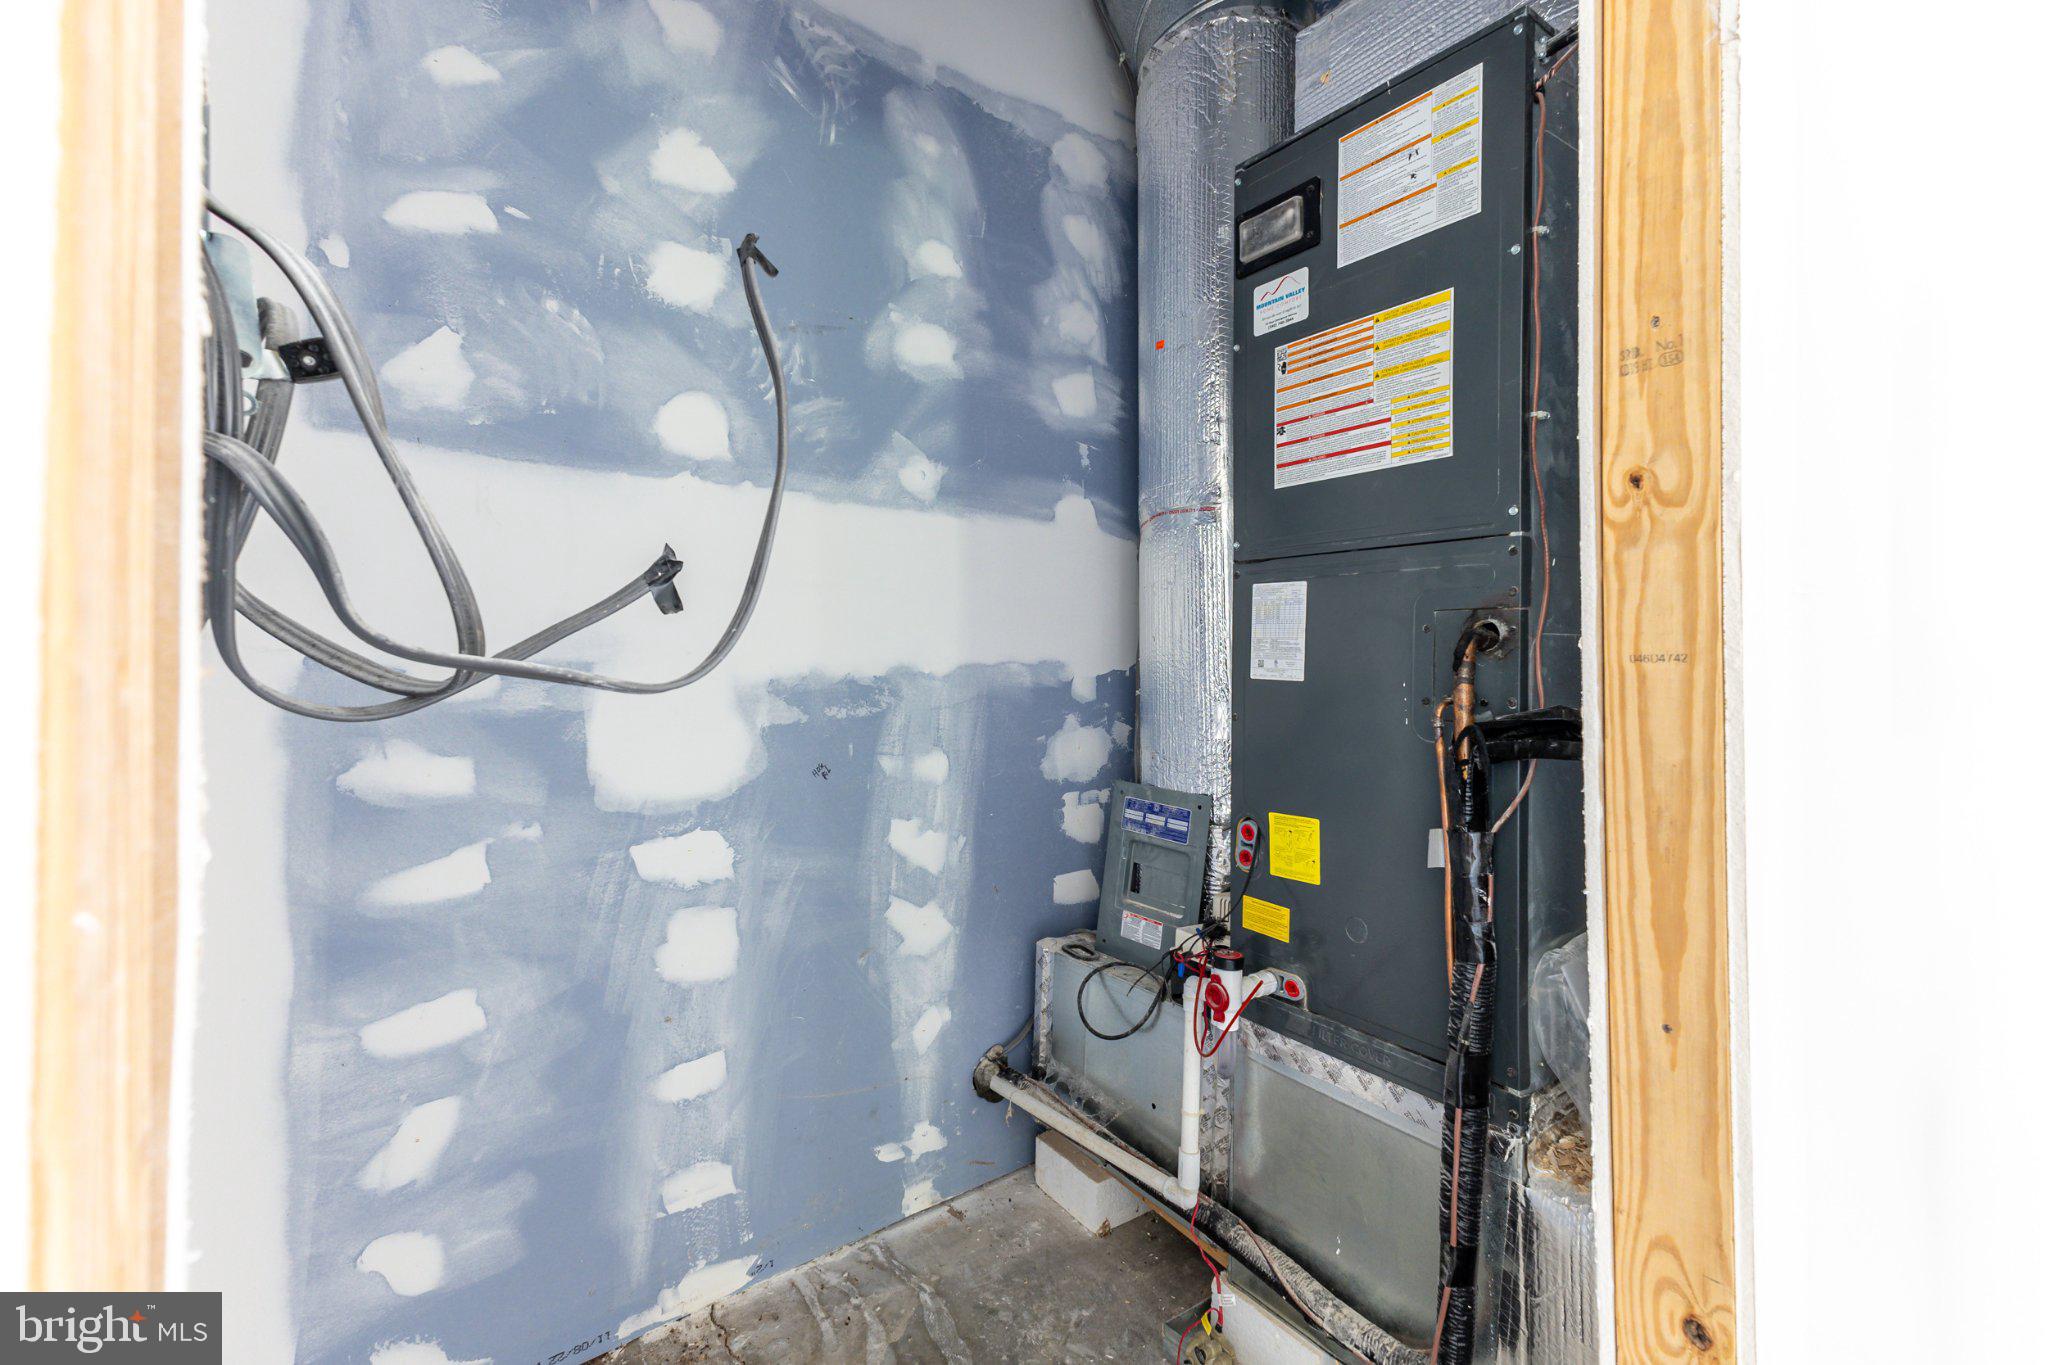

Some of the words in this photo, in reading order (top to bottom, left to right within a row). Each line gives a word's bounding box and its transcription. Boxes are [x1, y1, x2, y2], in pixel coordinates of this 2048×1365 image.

[1256, 295, 1285, 310] MOUNTAIN
[1285, 287, 1306, 299] VALLEY
[1349, 1040, 1392, 1067] COVER
